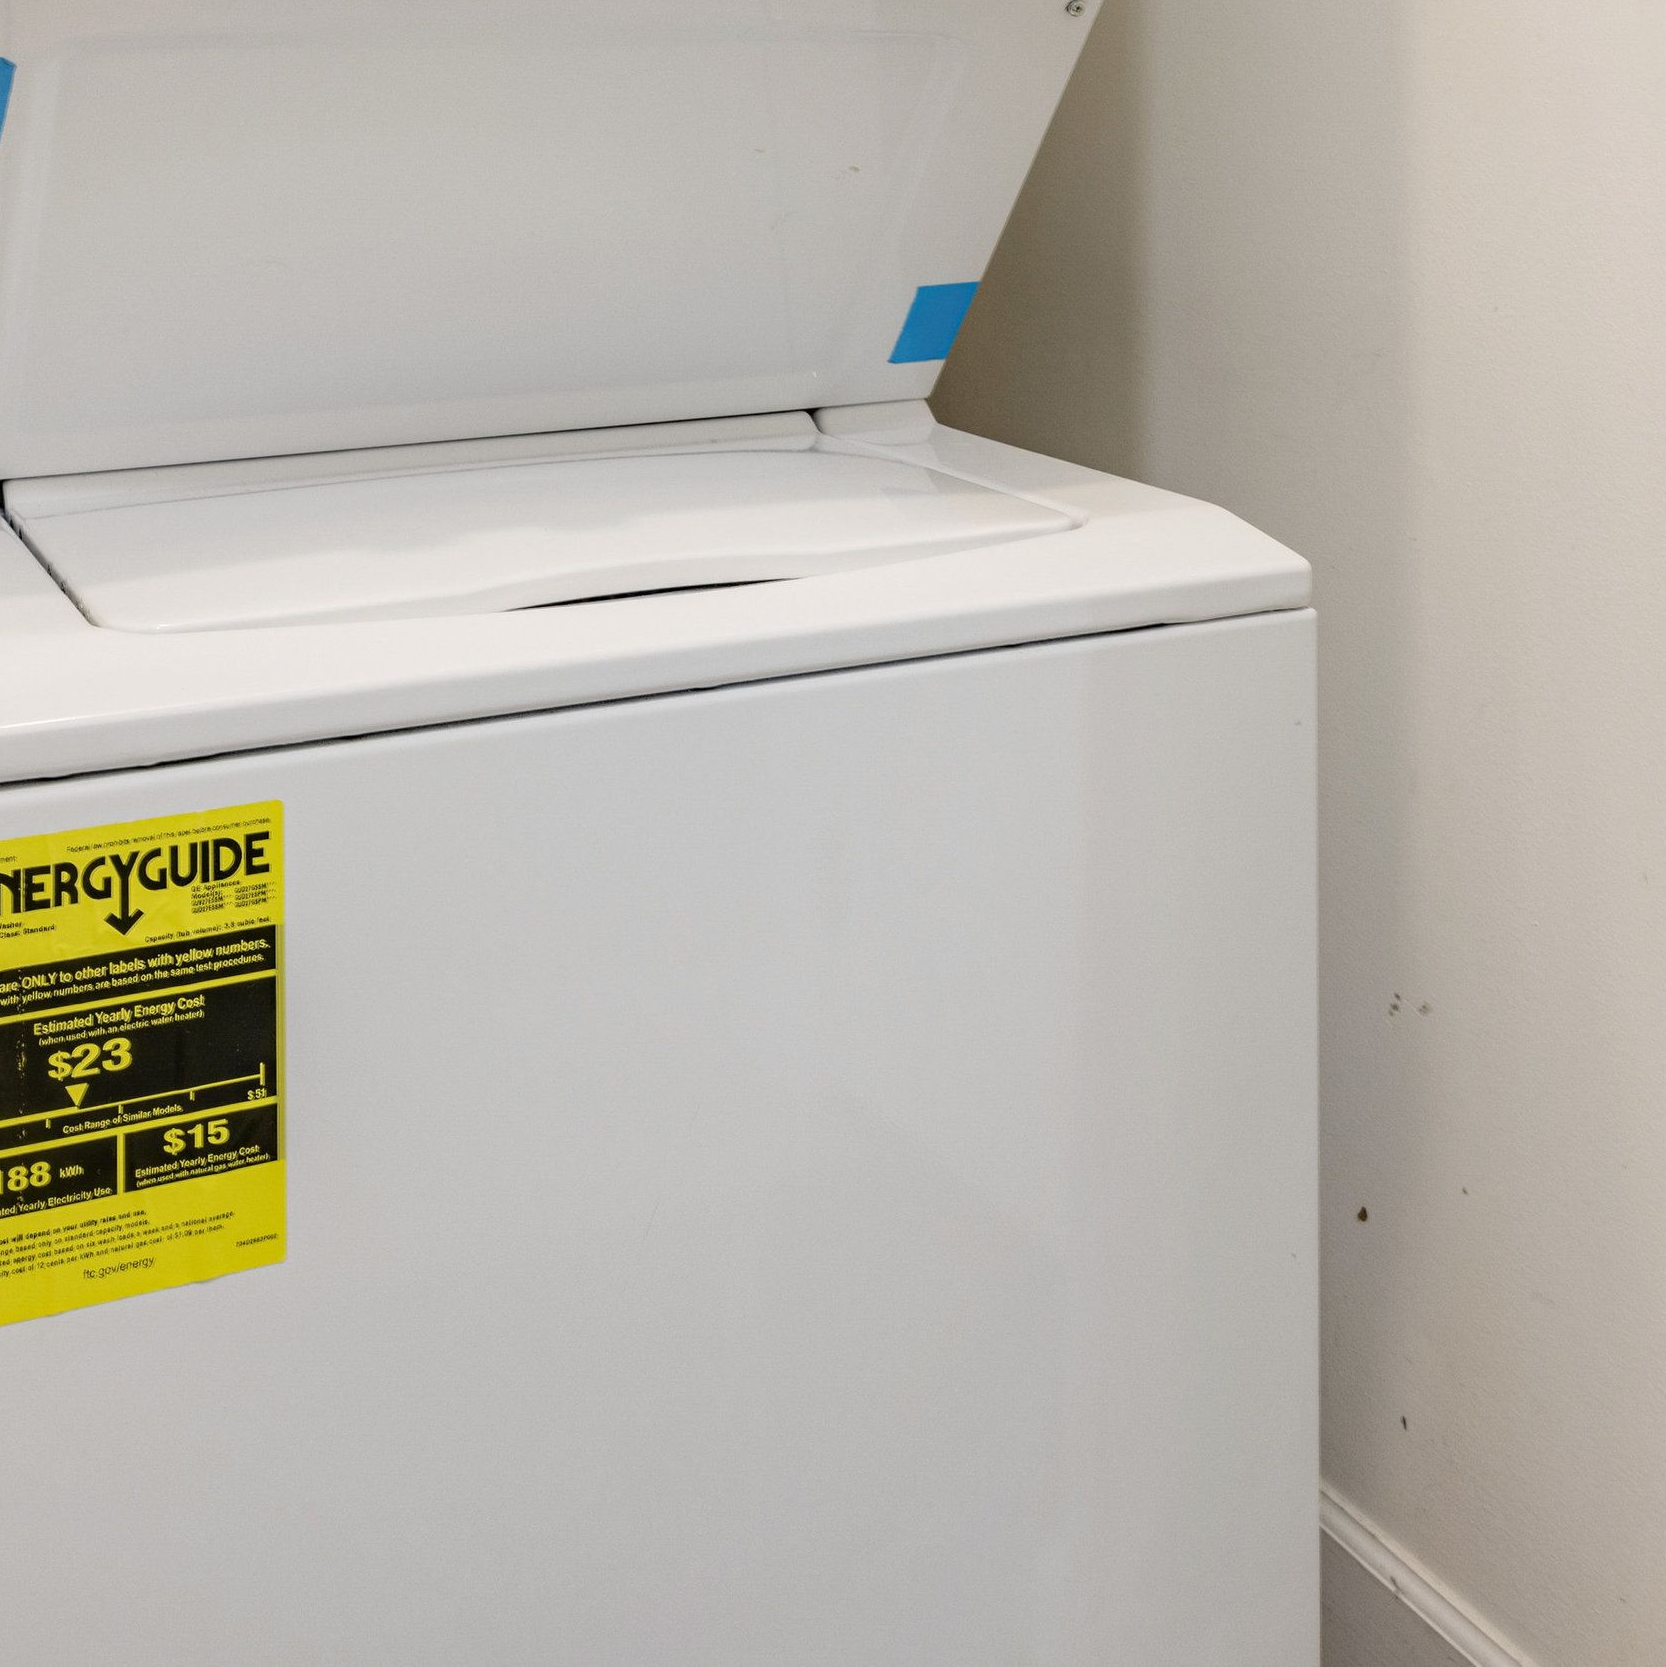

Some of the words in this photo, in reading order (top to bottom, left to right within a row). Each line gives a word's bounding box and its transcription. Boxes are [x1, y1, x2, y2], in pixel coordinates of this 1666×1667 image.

[23, 923, 55, 935] Standard
[21, 971, 56, 989] ONLY
[59, 969, 72, 983] to
[74, 963, 107, 981] other
[109, 956, 144, 975] labels
[147, 952, 173, 968] with
[175, 945, 212, 966] yellow
[215, 935, 270, 956] numbers.
[0, 994, 18, 1006] with
[21, 989, 50, 1004] yellow
[53, 982, 92, 997] numbers
[95, 980, 108, 989] are
[111, 973, 138, 986] based
[141, 972, 151, 981] on
[154, 968, 168, 979] the
[170, 965, 194, 977] same
[196, 961, 211, 972] test
[214, 952, 263, 970] procedures.
[33, 1013, 93, 1036] Estimated
[95, 1006, 132, 1027] Yearly
[134, 998, 175, 1021] Energy
[177, 993, 204, 1010] Cost
[38, 1034, 64, 1047] (when
[66, 1029, 86, 1041] used
[88, 1026, 105, 1037] with
[107, 1025, 117, 1034] an
[119, 1018, 148, 1032] electric
[150, 1014, 173, 1026] water
[174, 1008, 204, 1022] heater)
[48, 1037, 132, 1081] $23
[62, 1122, 83, 1134] Cost
[85, 1117, 110, 1132] Range
[113, 1114, 121, 1124] of
[123, 1108, 150, 1122] Similar
[152, 1102, 181, 1117] Models
[163, 1118, 230, 1156] $15
[60, 1164, 84, 1179] kWh
[135, 1161, 177, 1178] Estimated
[179, 1154, 206, 1171] Yearly
[207, 1148, 237, 1165] Energy
[239, 1143, 259, 1156] Cost
[156, 1172, 174, 1183] used
[175, 1169, 188, 1179] with
[190, 1164, 213, 1176] natural
[17, 1198, 46, 1214] Yearly
[48, 1189, 91, 1208] Electricity
[94, 1184, 111, 1197] Use
[11, 1233, 23, 1242] will
[25, 1228, 50, 1241] depend
[63, 1223, 77, 1233] your
[83, 1254, 154, 1282] ftc.gov/energy
